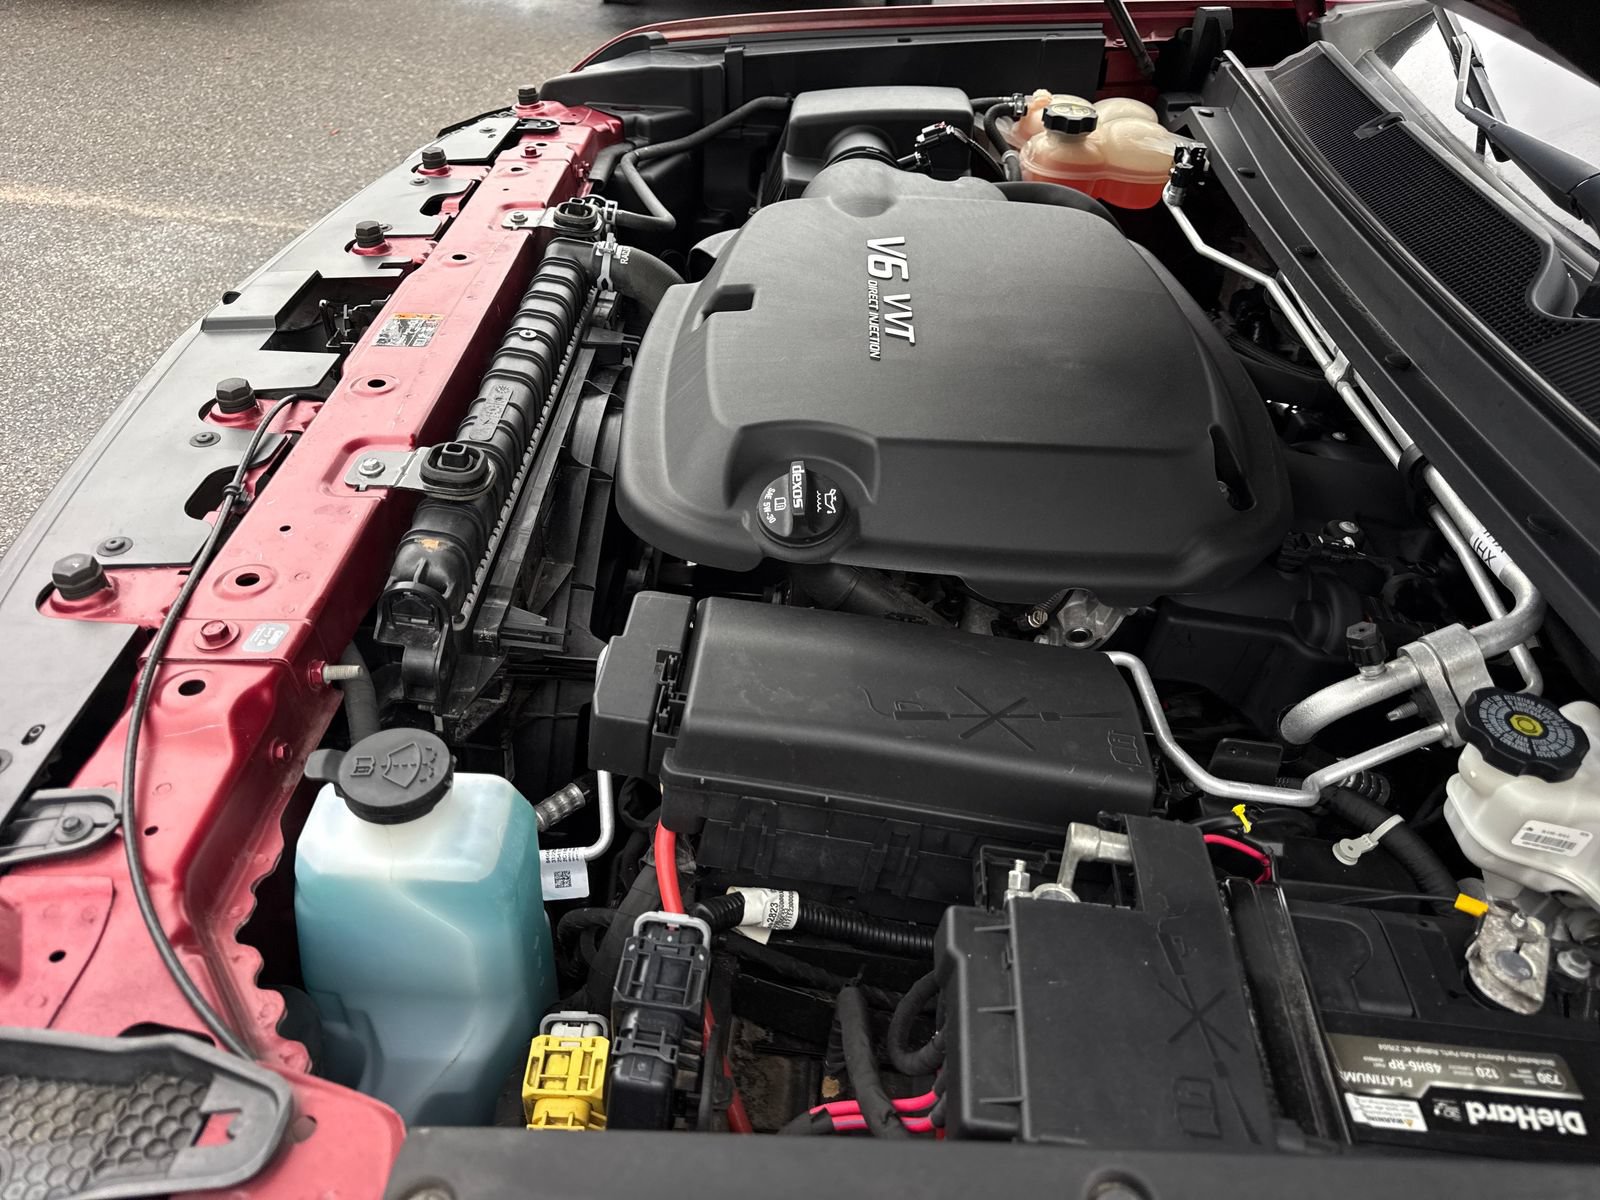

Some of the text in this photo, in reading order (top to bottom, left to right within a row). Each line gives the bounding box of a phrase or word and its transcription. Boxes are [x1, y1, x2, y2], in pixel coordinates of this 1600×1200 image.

[866, 236, 915, 346] V6 VVT
[867, 280, 880, 360] DIRECT INJECTION
[791, 465, 805, 509] dexos
[763, 487, 777, 524] SAE 5W-30
[1342, 1071, 1413, 1088] PLATINUM
[1475, 1066, 1499, 1079] 120
[1536, 1072, 1562, 1085] 730
[1465, 1101, 1587, 1136] DieHard
